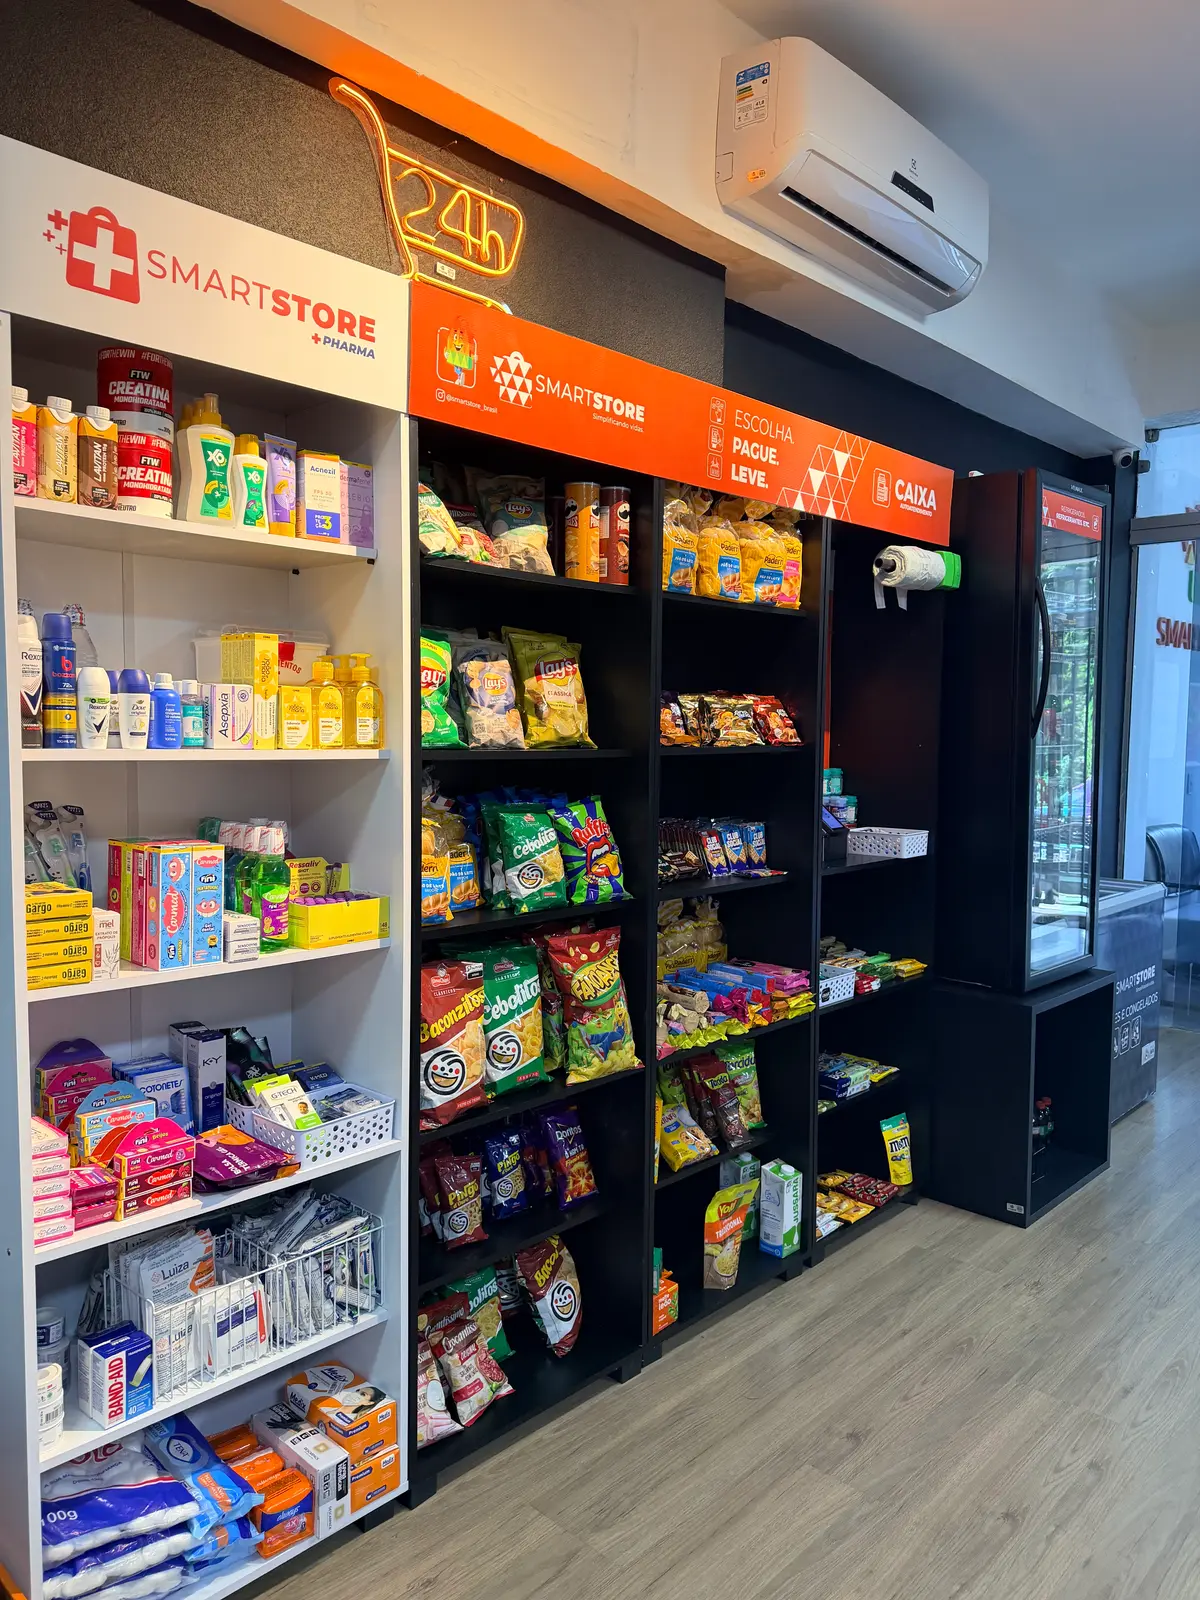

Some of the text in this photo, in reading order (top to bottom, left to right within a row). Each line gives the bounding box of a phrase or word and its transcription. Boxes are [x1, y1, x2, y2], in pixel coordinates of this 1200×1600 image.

[396, 168, 505, 262] 24h
[147, 249, 376, 343] SMARTSTORE
[130, 369, 150, 380] FTW
[109, 381, 170, 403] CREATINA
[535, 373, 645, 422] SMARTSTORE
[114, 396, 167, 409] MONOHIDRATADA
[446, 394, 498, 414] @smartstore_brasil
[592, 412, 630, 429] Simplificando
[735, 409, 795, 444] ESCOLHA.
[55, 432, 64, 475] LAVITAN
[733, 436, 779, 466] PAGUE.
[93, 441, 102, 482] LAVITAN
[141, 456, 161, 466] FTW
[731, 463, 768, 489] LEVE.
[895, 479, 936, 511] CAIXA
[22, 651, 42, 661] Rexo
[278, 660, 302, 674] ENTOS
[539, 658, 575, 680] Lay's
[483, 676, 507, 690] Lay's
[131, 703, 146, 711] Dove
[218, 692, 230, 738] Asepxia
[571, 817, 611, 847] Ruffles
[513, 828, 557, 859] Cebolitos
[196, 857, 220, 866] Carmed
[26, 902, 52, 915] Gargo
[166, 889, 179, 934] Carmed
[63, 922, 88, 935] Gargo
[62, 945, 87, 957] Gargo
[61, 968, 86, 980] Gargo
[1116, 965, 1155, 995] SMARTSTORE
[1125, 992, 1158, 1017] CONGELADOS
[420, 986, 485, 1043] Baconzitos
[140, 1079, 185, 1094] COTONETES
[204, 1092, 222, 1100] original
[105, 1111, 132, 1124] Carmed
[555, 1125, 582, 1140] Doritos
[146, 1152, 174, 1164] Carmed
[221, 1158, 241, 1175] BOLSA
[147, 1173, 175, 1184] Carmed
[145, 1194, 173, 1206] Carmed
[161, 1259, 189, 1280] Luiza
[442, 1322, 477, 1355] Crocantiss
[108, 1357, 124, 1419] BAND-AID
[128, 1406, 137, 1415] 40
[379, 1410, 391, 1420] Medix
[348, 1423, 368, 1435] Premium
[382, 1456, 394, 1467] Medix
[352, 1469, 371, 1481] Premium
[276, 1505, 301, 1521] always
